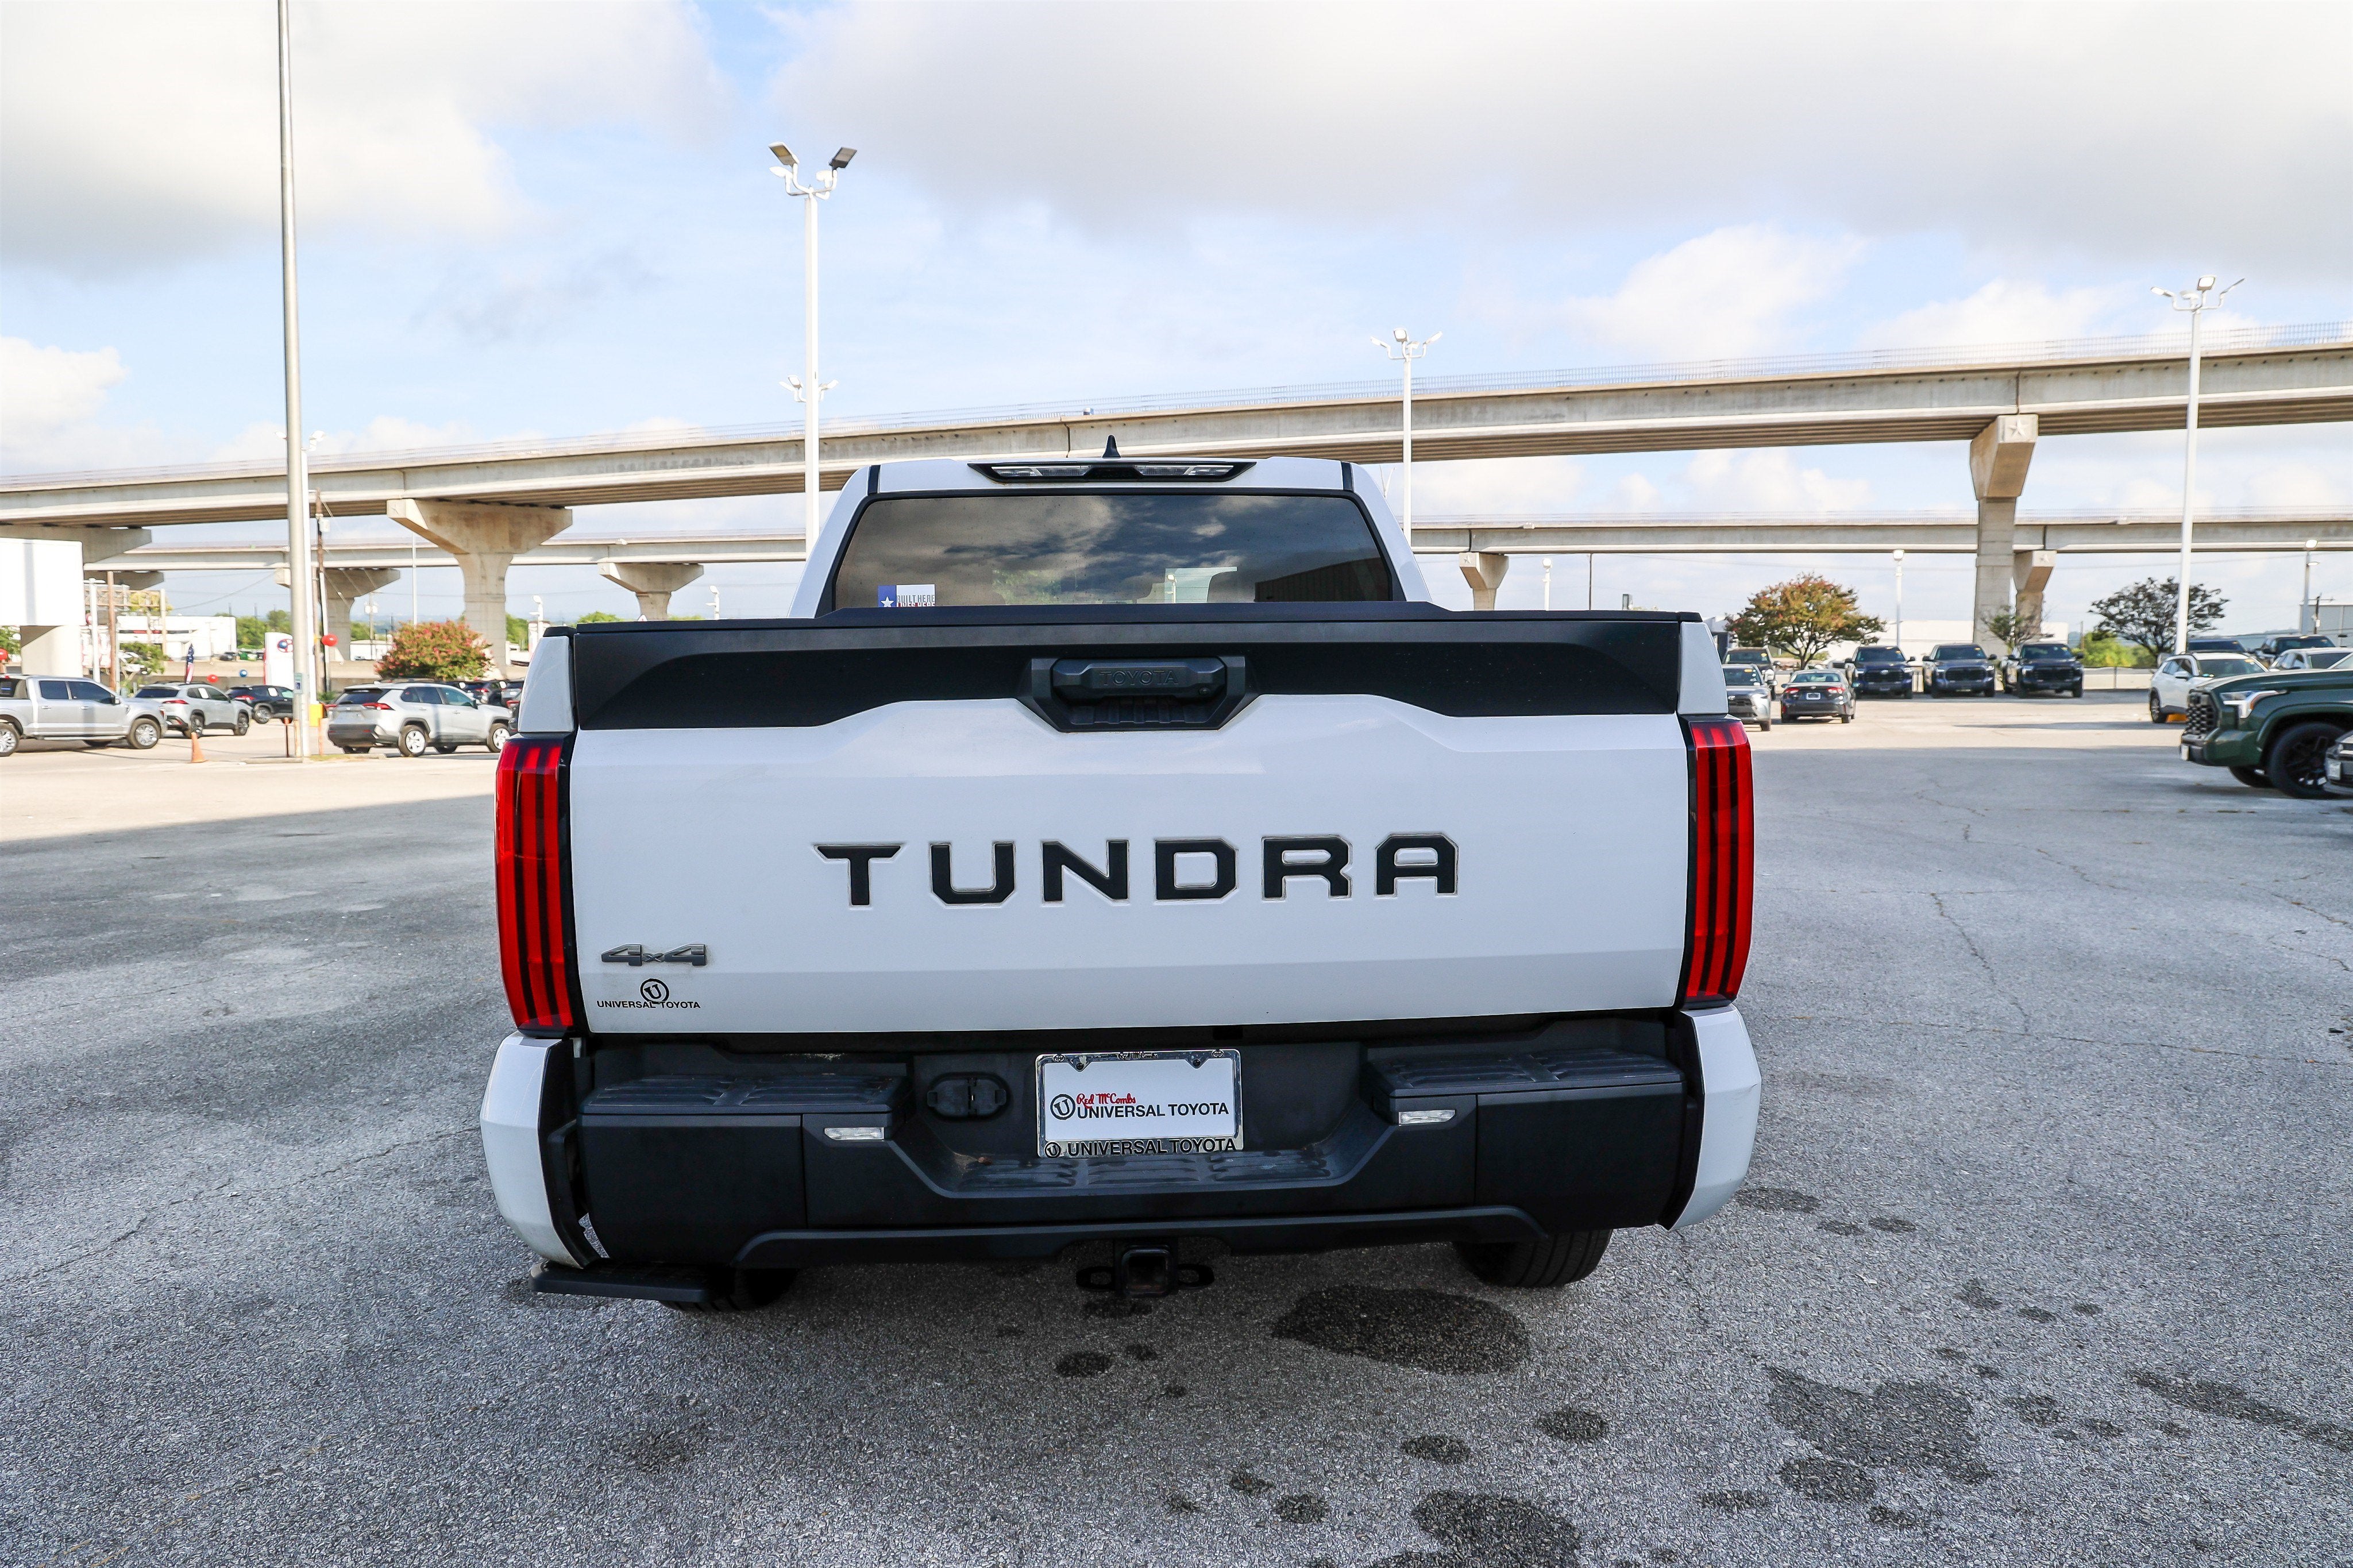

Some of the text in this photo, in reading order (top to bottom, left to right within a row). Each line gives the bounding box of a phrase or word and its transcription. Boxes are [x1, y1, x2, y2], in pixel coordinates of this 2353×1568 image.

[897, 594, 935, 603] BUILT HERE
[1099, 670, 1179, 686] TOYOTA
[813, 833, 1459, 907] TUNDRA
[596, 1000, 656, 1009] UNIVERSAL
[1076, 1093, 1094, 1109] Red
[1077, 1103, 1229, 1119] UNIVERSAL TOYOTA
[1067, 1138, 1237, 1157] UNIVERSAL TOYOTA
